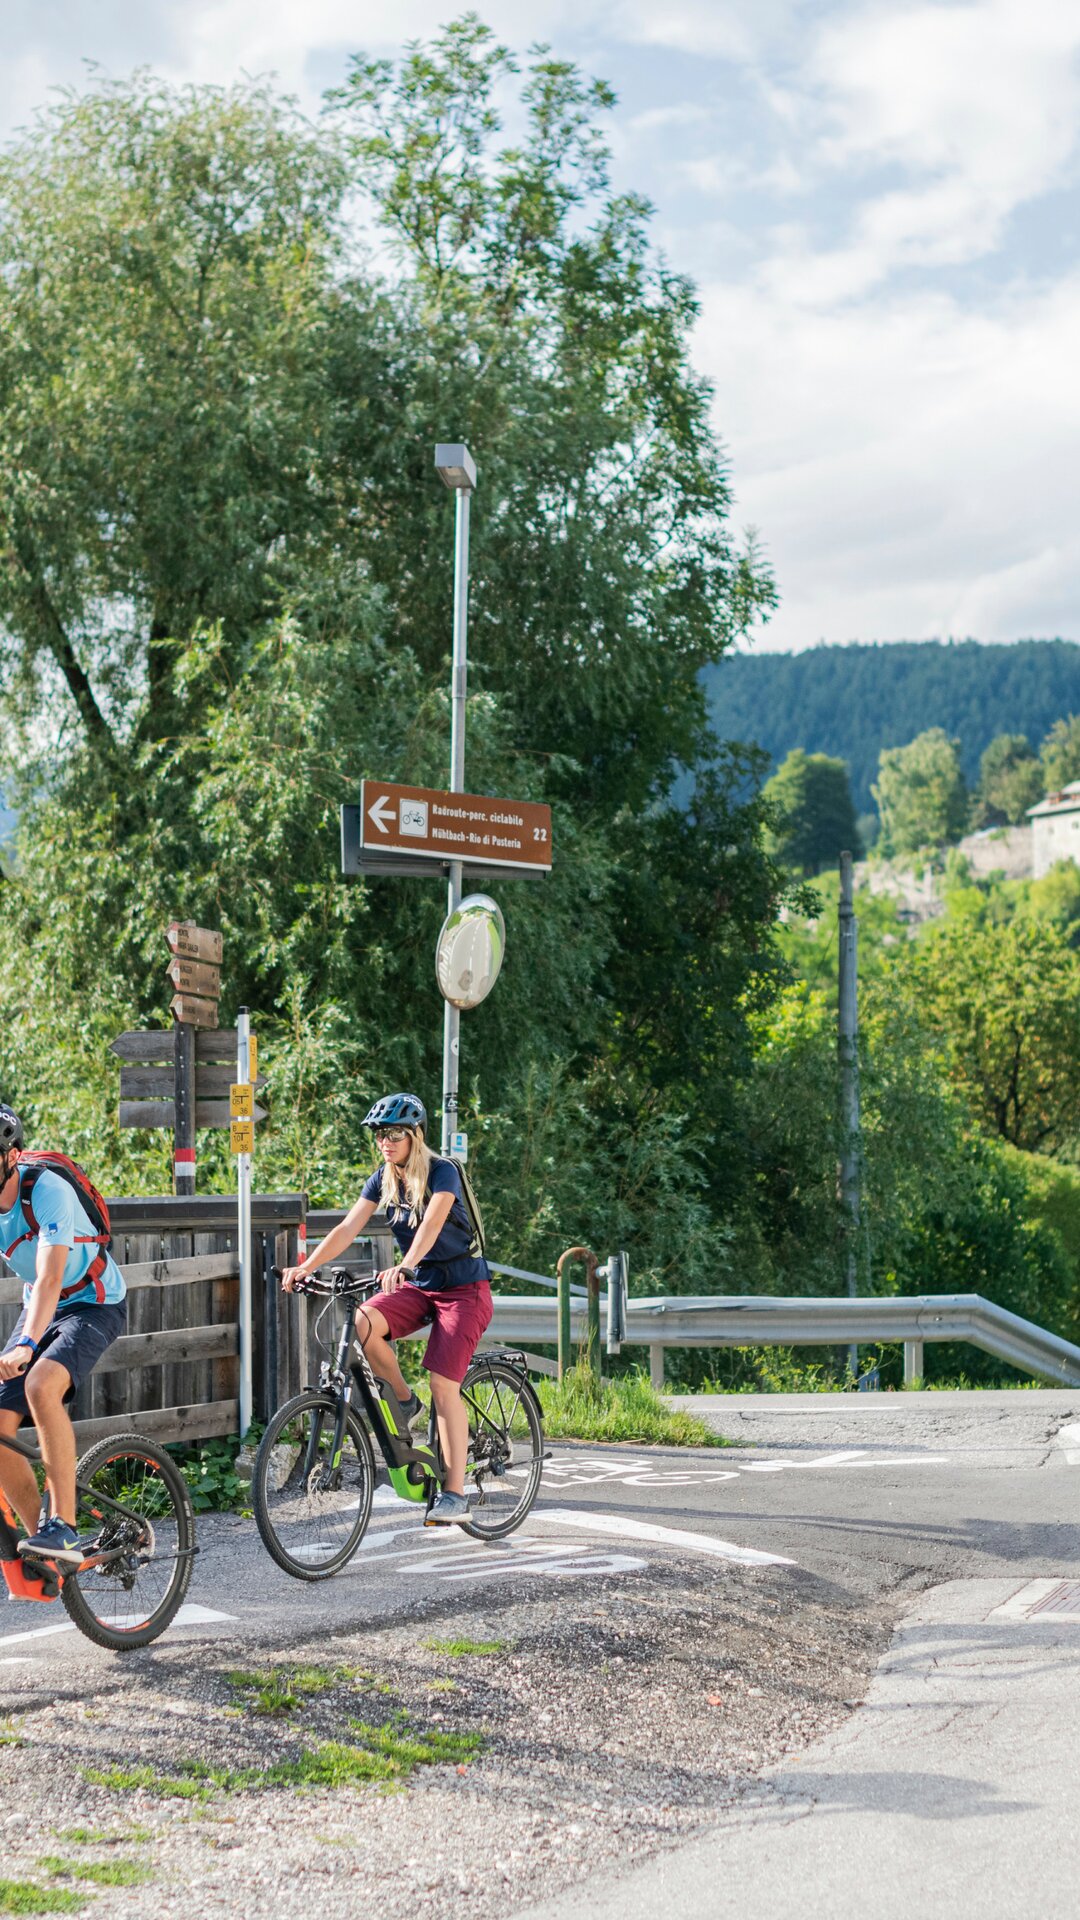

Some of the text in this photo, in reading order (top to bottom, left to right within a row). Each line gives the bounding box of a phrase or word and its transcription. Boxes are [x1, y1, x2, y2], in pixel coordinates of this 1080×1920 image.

[490, 812, 523, 826] ciclabile
[482, 834, 490, 845] di
[492, 835, 521, 849] Pusteria
[533, 828, 547, 841] 22
